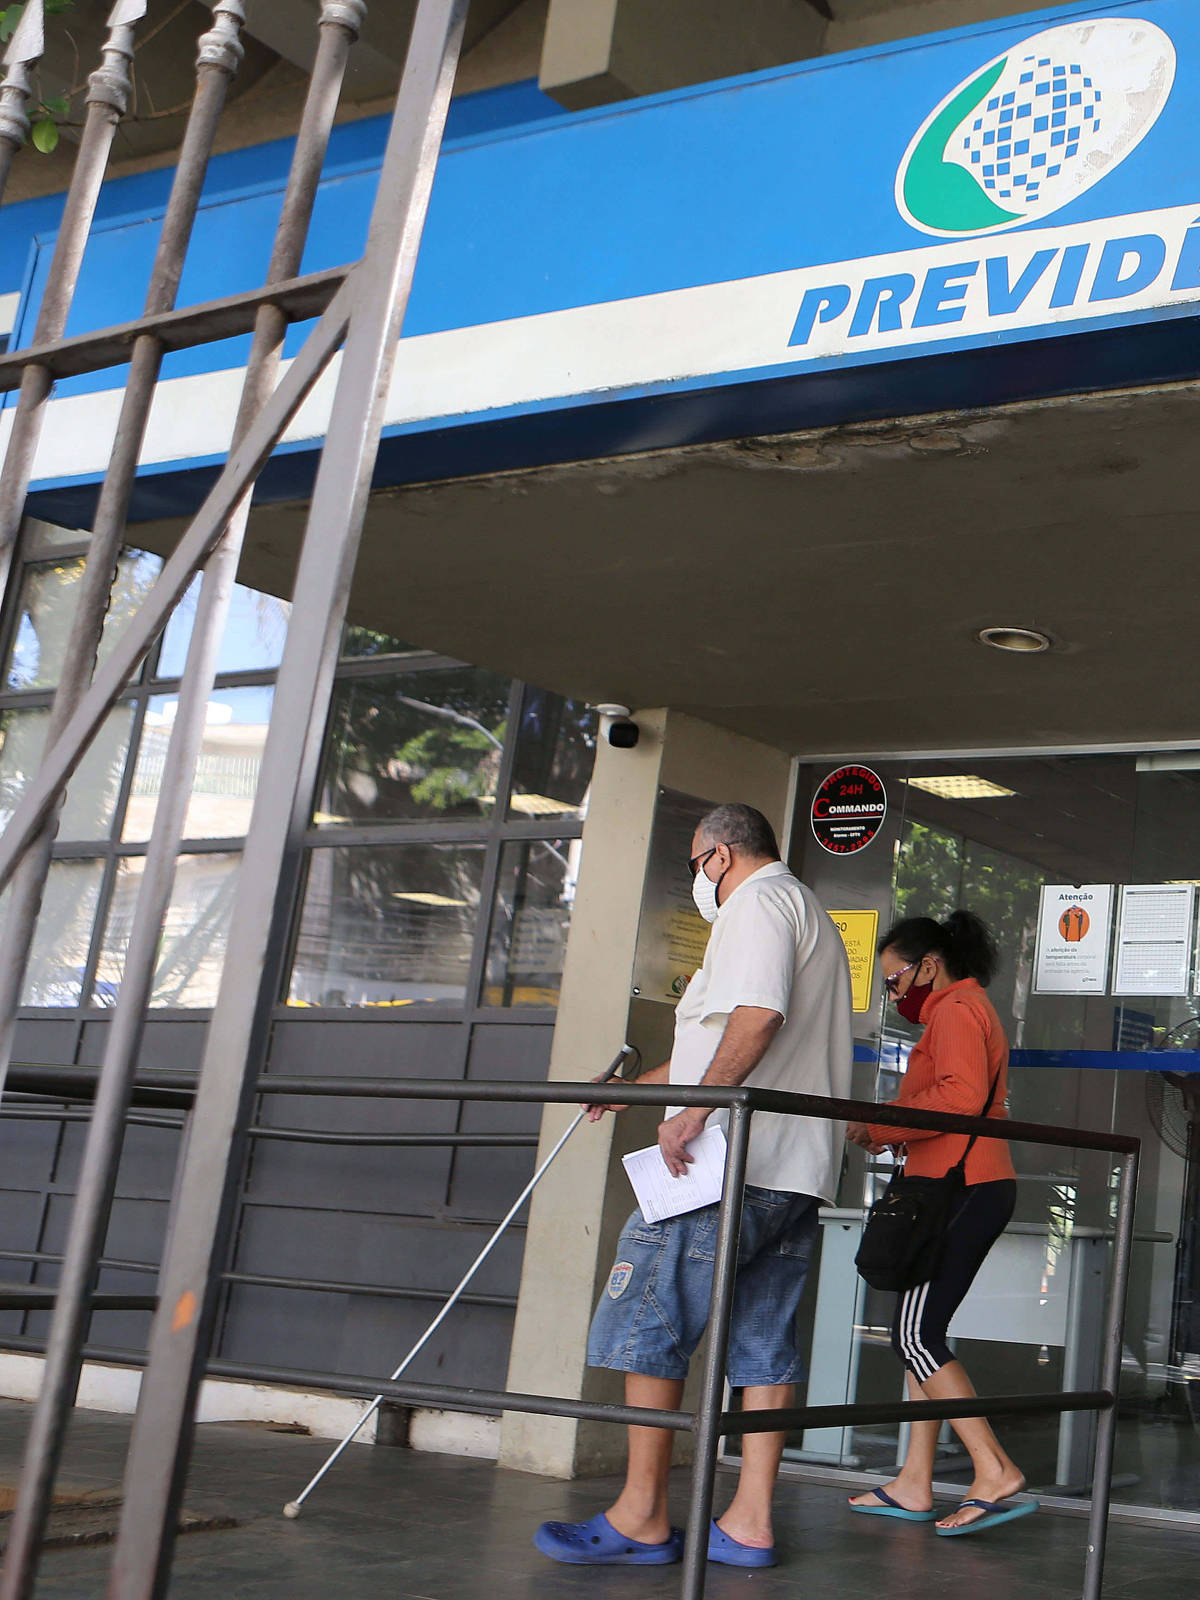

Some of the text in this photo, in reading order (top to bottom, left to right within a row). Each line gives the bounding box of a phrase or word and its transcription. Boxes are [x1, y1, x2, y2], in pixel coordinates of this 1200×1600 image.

[822, 767, 881, 791] PROTEGIDO
[840, 784, 864, 796] 24H
[1058, 892, 1094, 902] Atenção
